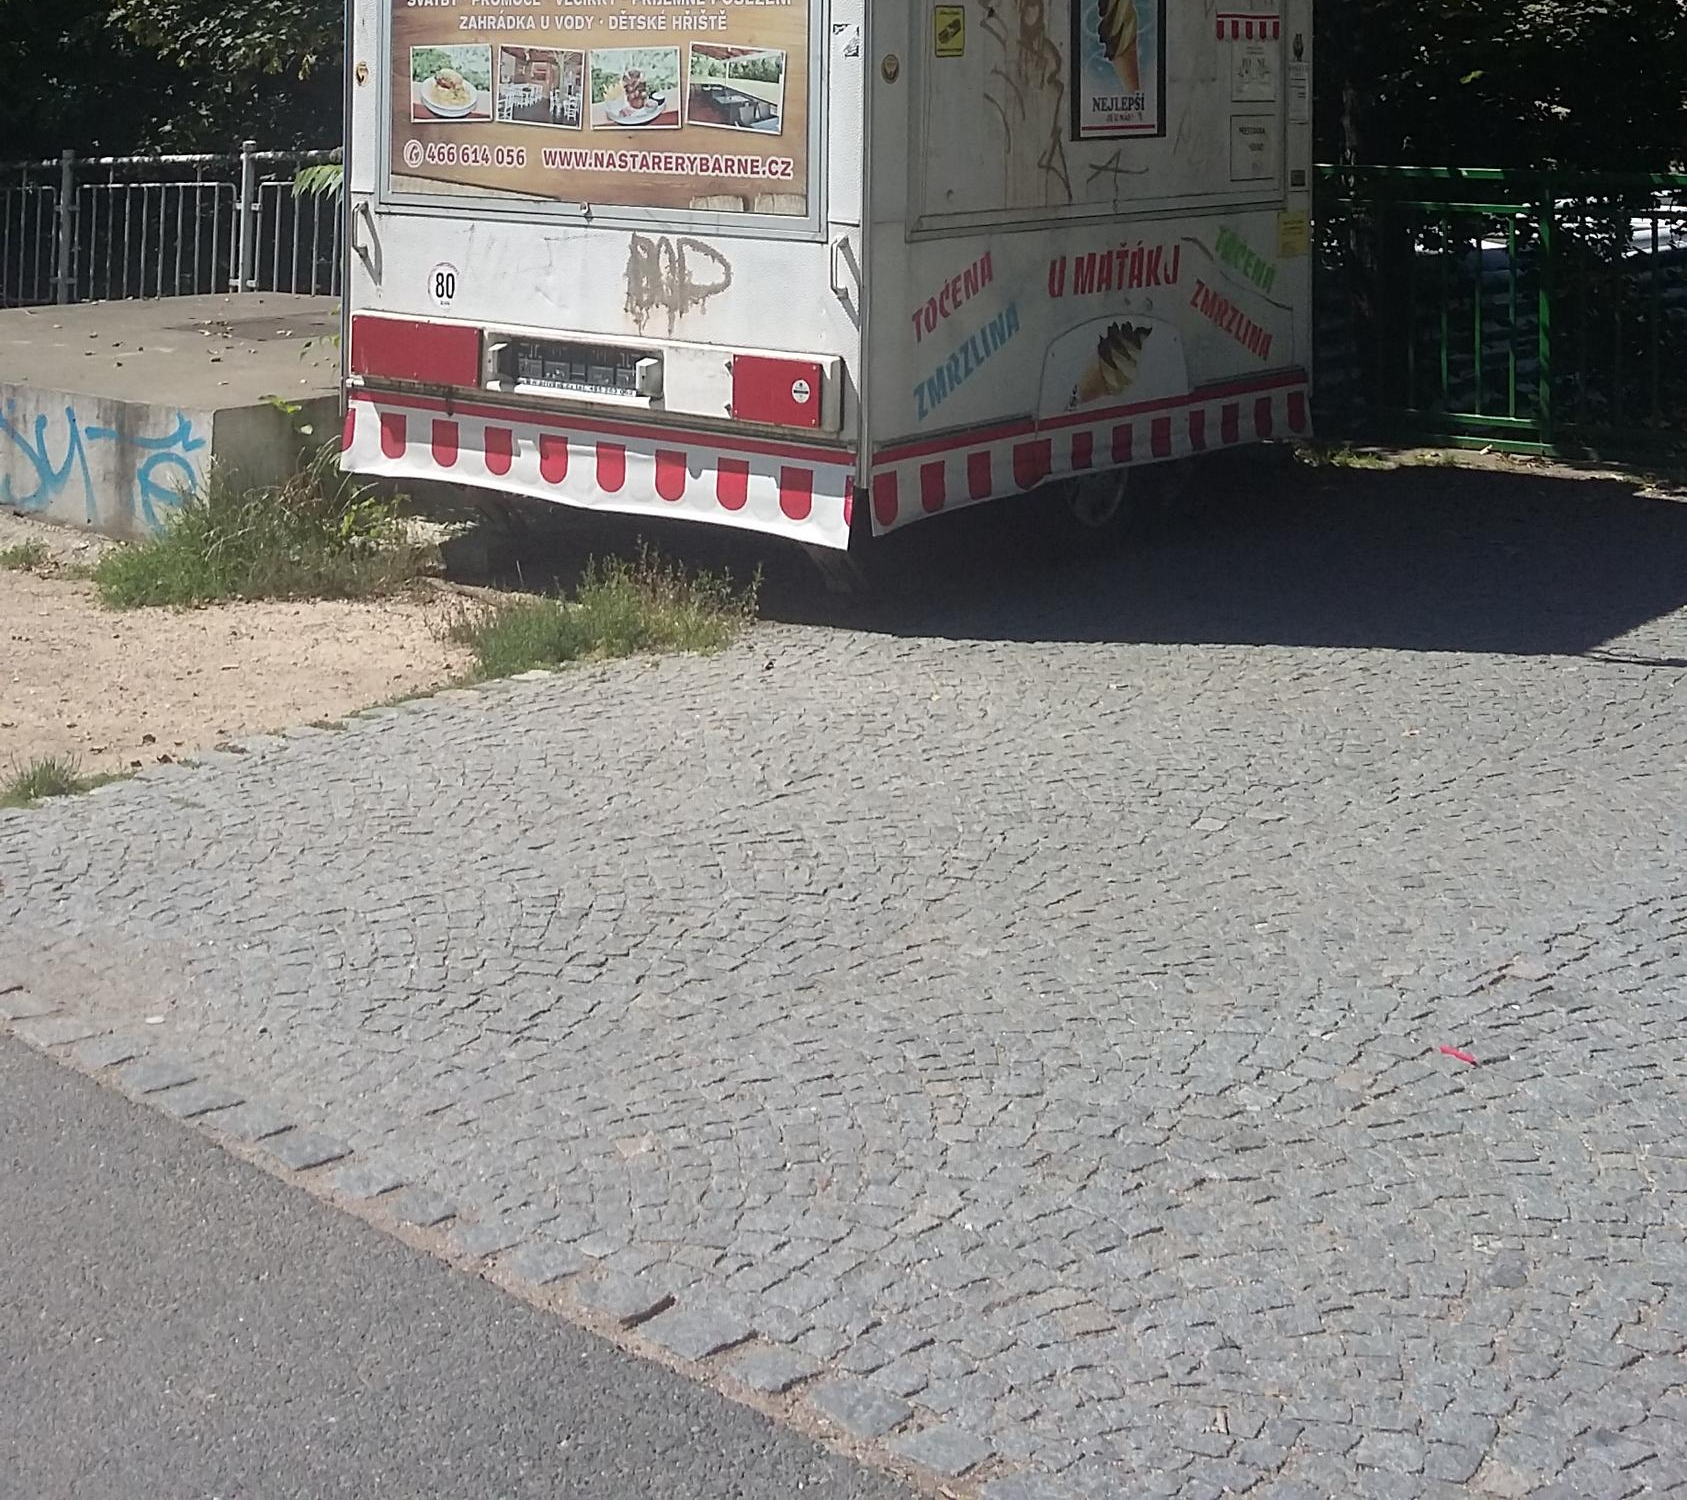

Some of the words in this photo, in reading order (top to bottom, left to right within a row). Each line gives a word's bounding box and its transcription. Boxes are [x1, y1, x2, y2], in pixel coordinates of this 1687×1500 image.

[459, 10, 536, 31] ZAHRÁDKA
[540, 16, 550, 31] U
[554, 15, 595, 31] VODY
[608, 10, 667, 31] DĚTSKÉ
[671, 8, 728, 31] HŘIŠTĚ
[1092, 92, 1146, 113] NEJLEPŠÍ
[426, 145, 456, 164] 466
[460, 146, 491, 165] 614
[495, 148, 525, 167] 056
[543, 149, 793, 178] WWW.NASTARERYBARNE.CZ
[435, 272, 456, 300] 80
[1048, 256, 1067, 298] U
[1190, 279, 1273, 361] ZMRZLINA
[913, 302, 1020, 421] ZMRZLINA
